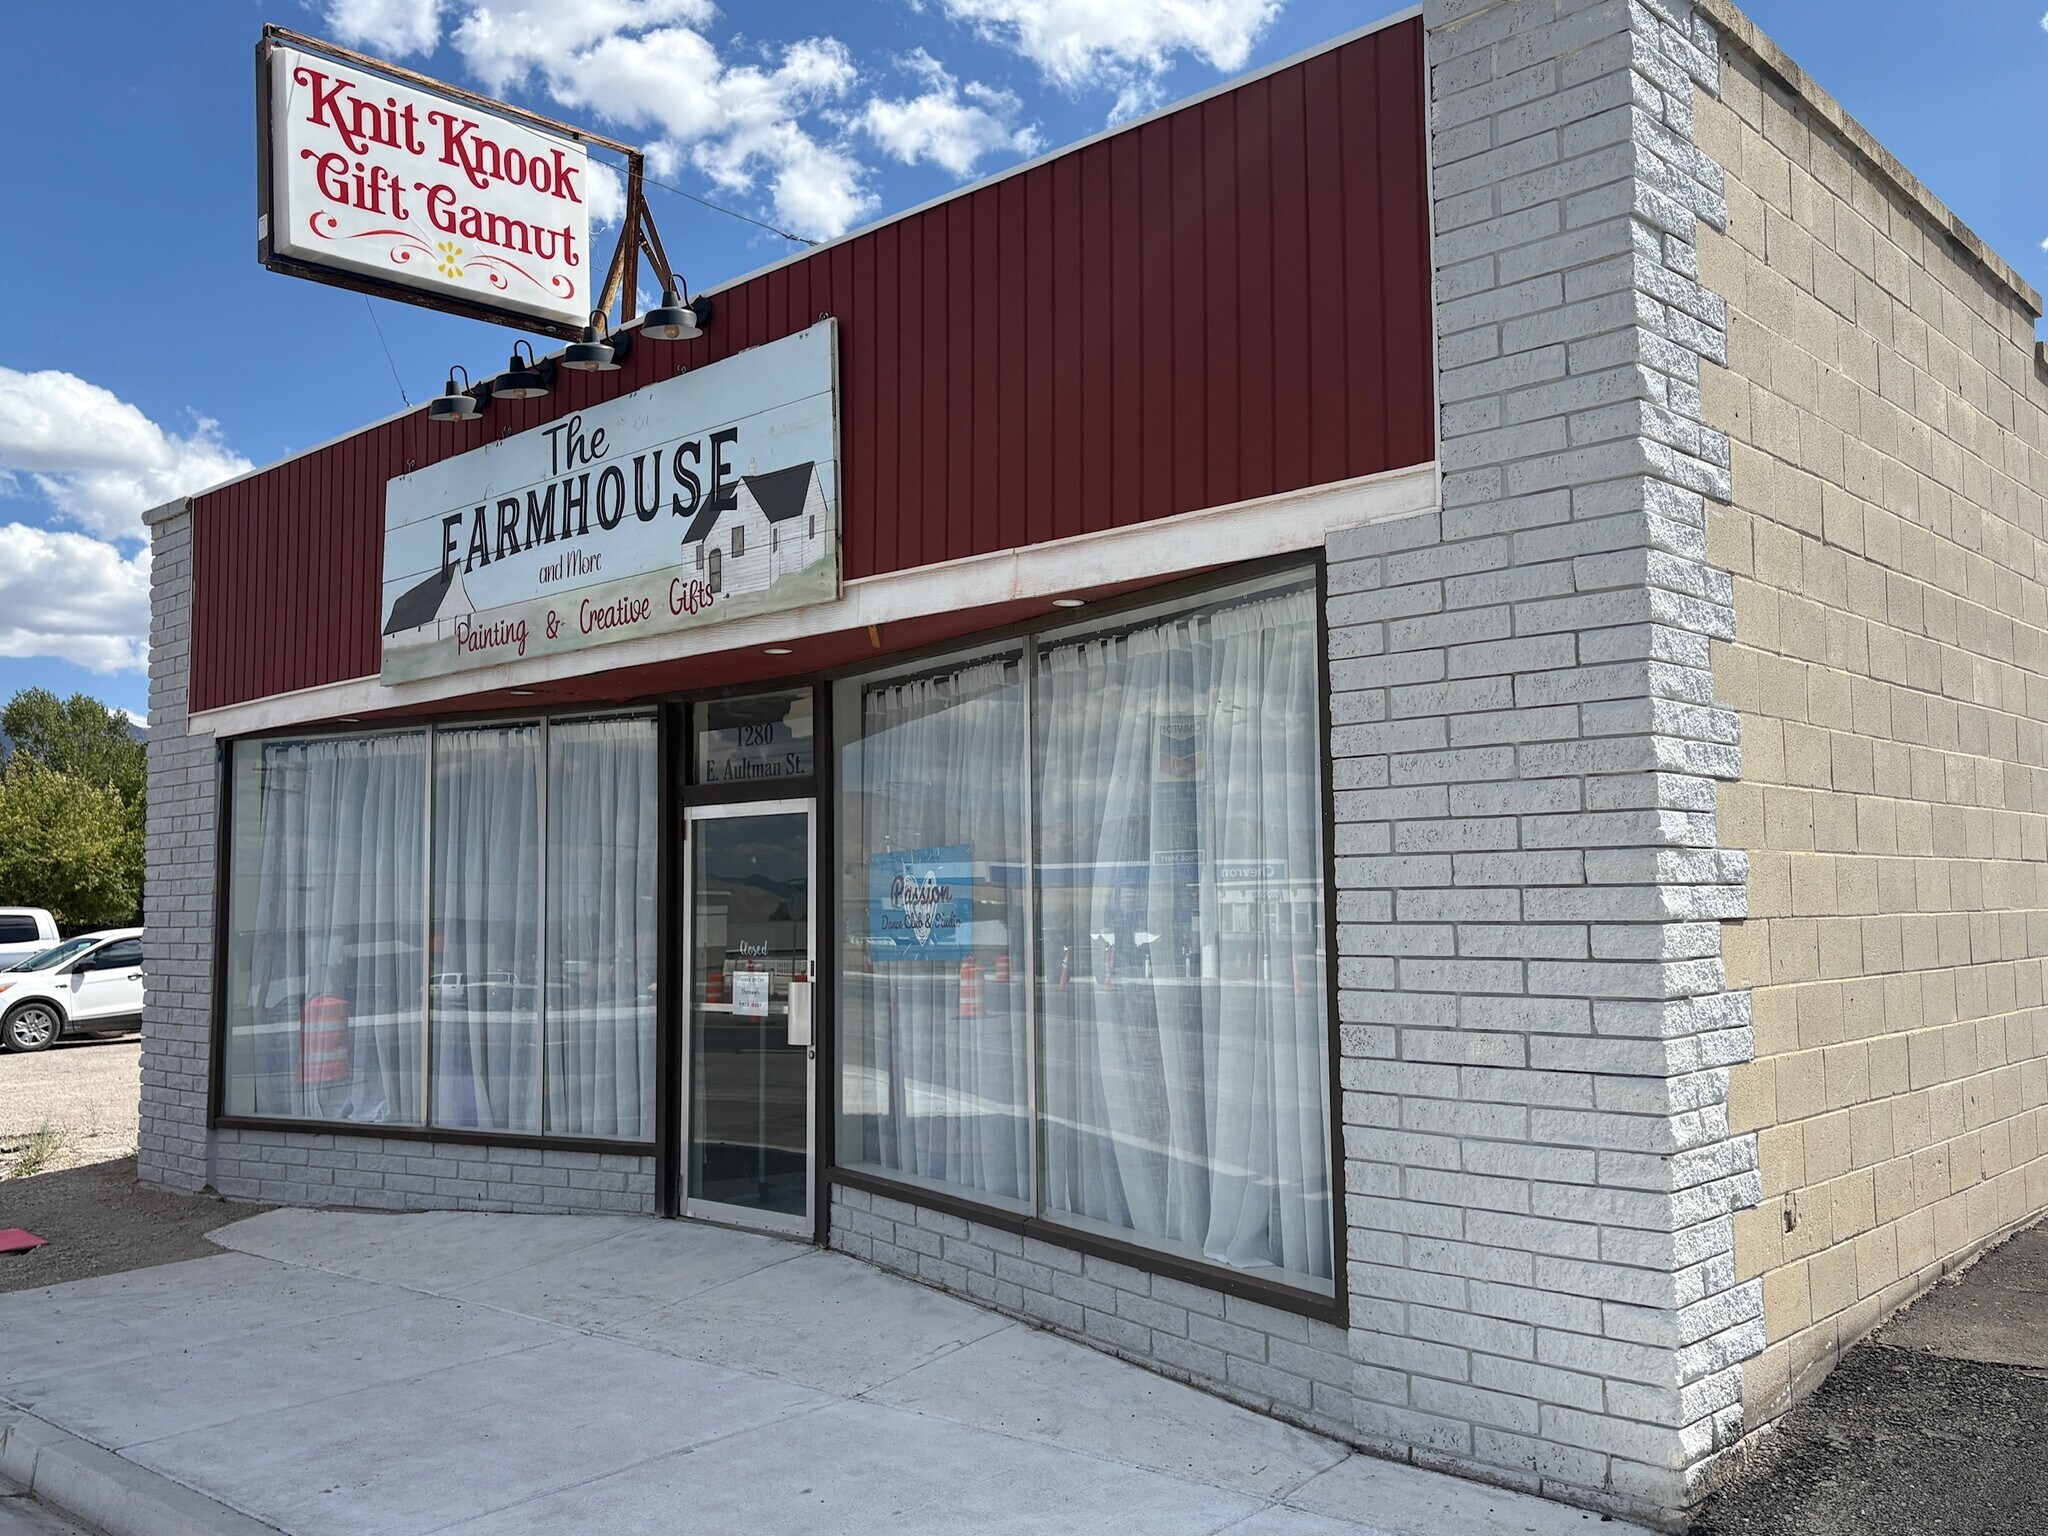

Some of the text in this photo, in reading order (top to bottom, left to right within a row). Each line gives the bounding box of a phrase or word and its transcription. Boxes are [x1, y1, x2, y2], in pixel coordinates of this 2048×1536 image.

[294, 66, 583, 204] Knit Knook
[300, 148, 579, 267] Gift Gamut
[541, 414, 609, 476] The
[440, 426, 738, 584] FARMHOUSE
[539, 554, 563, 584] and
[456, 577, 715, 657] Painting & Creative Gifts
[736, 722, 774, 747] 1280
[706, 752, 805, 782] E. Aultman St.
[890, 874, 953, 909] Passion
[881, 911, 962, 930] Dance Club & Studio
